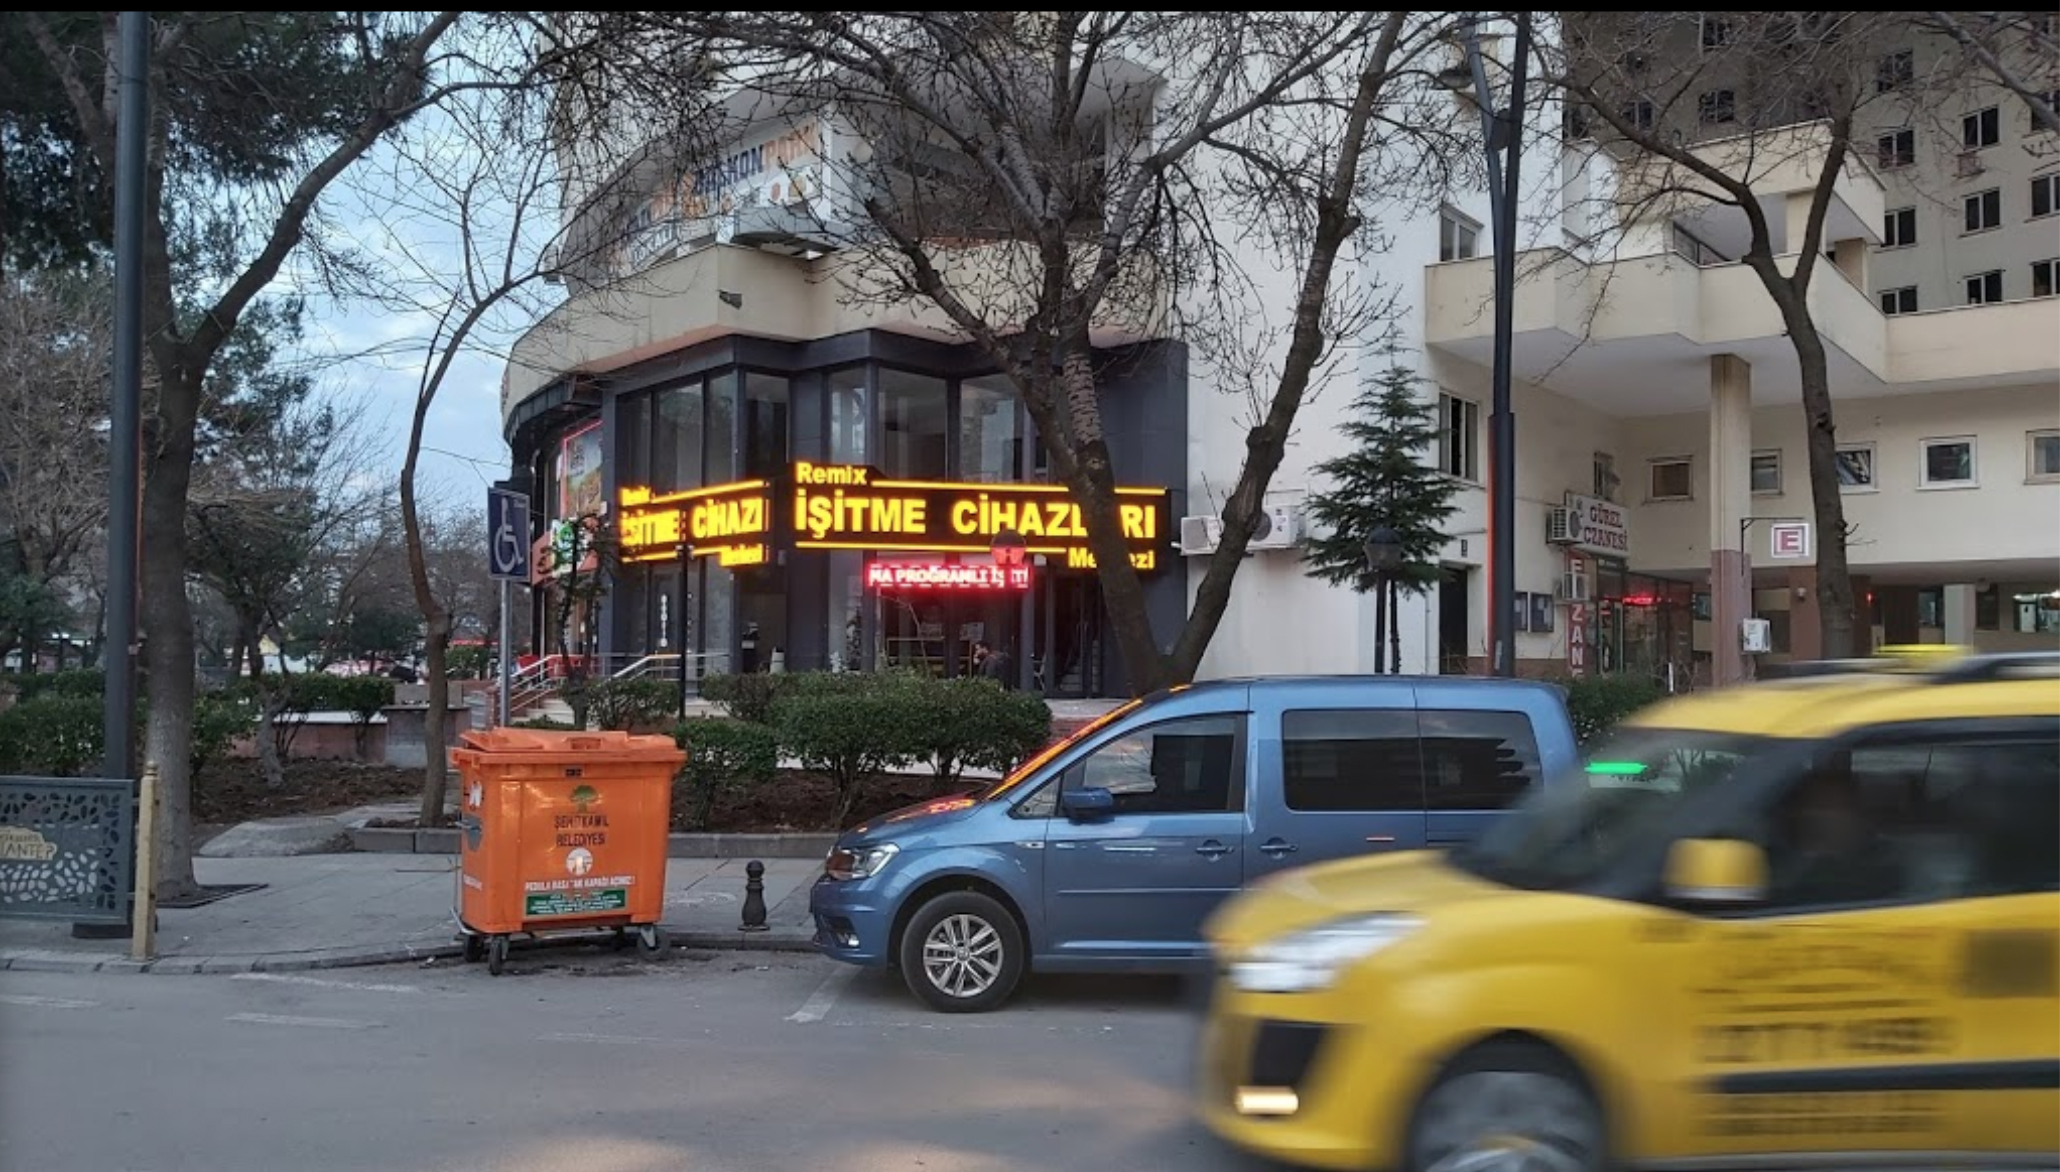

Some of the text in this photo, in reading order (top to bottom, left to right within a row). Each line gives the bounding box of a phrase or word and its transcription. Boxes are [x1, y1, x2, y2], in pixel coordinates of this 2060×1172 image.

[796, 461, 867, 485] Remix
[692, 497, 763, 538] CİHAZI
[795, 488, 1155, 539] İŞİTME CİHAZLRI
[1781, 531, 1799, 550] E
[1068, 547, 1154, 569] Mezi
[1571, 559, 1584, 678] EZAN
